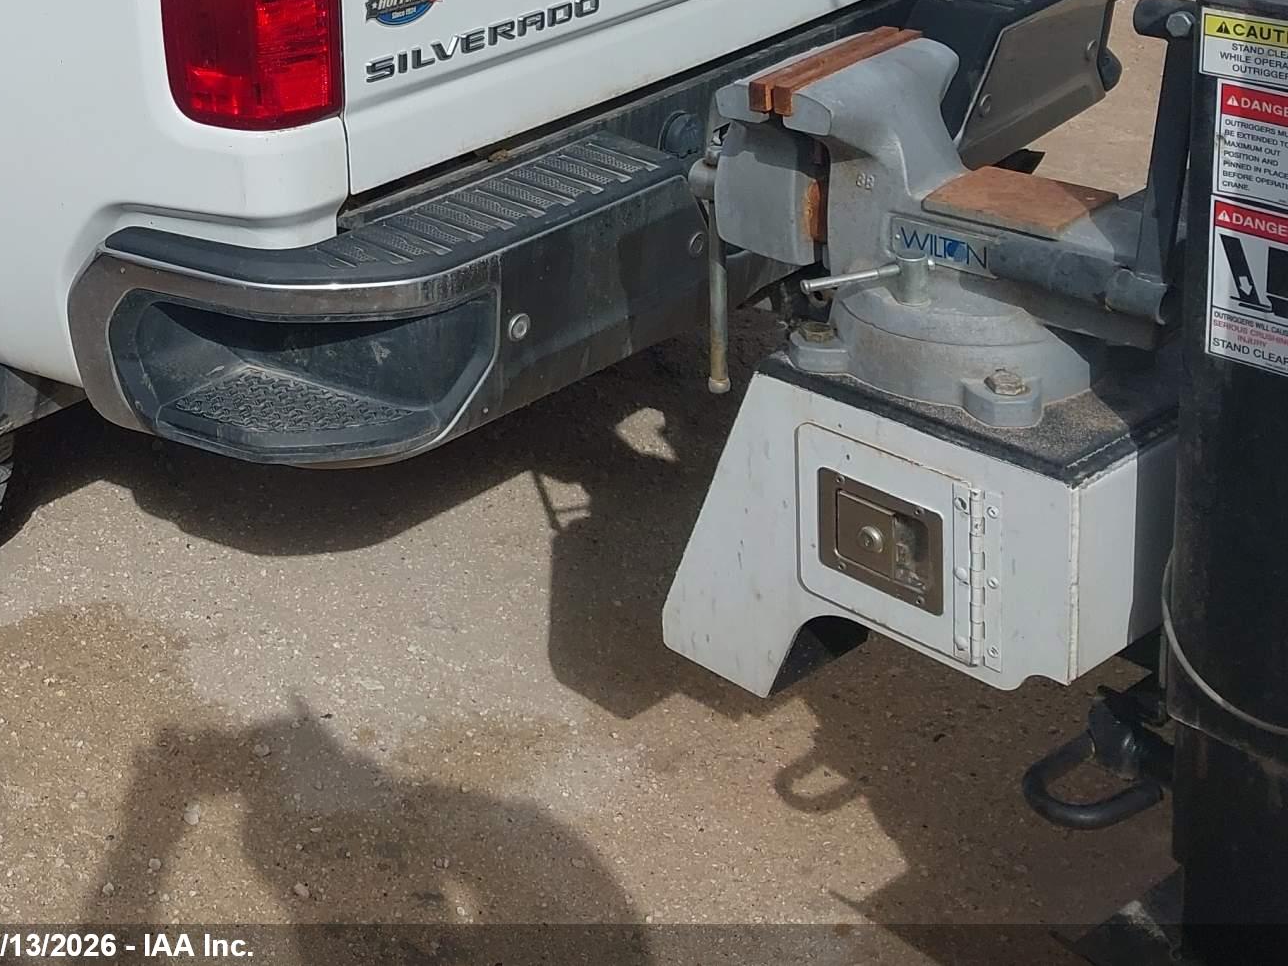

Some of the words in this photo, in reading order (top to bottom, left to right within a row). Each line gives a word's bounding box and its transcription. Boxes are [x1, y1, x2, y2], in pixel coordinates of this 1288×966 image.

[1220, 52, 1251, 64] WHILE
[1232, 43, 1264, 55] STAND
[1267, 49, 1288, 60] CLE
[1224, 119, 1275, 135] OUTRIGGERS
[1224, 129, 1235, 137] BE
[1237, 132, 1278, 146] EXTENDED
[1224, 140, 1263, 153] MAXIMUM
[1264, 147, 1280, 156] OUT
[1223, 150, 1260, 163] POSITION
[1261, 158, 1279, 167] AND
[1223, 160, 1252, 171] PINNED
[1222, 170, 1254, 182] BEFORE
[899, 226, 987, 270] WILTON
[1212, 337, 1250, 355] STAND
